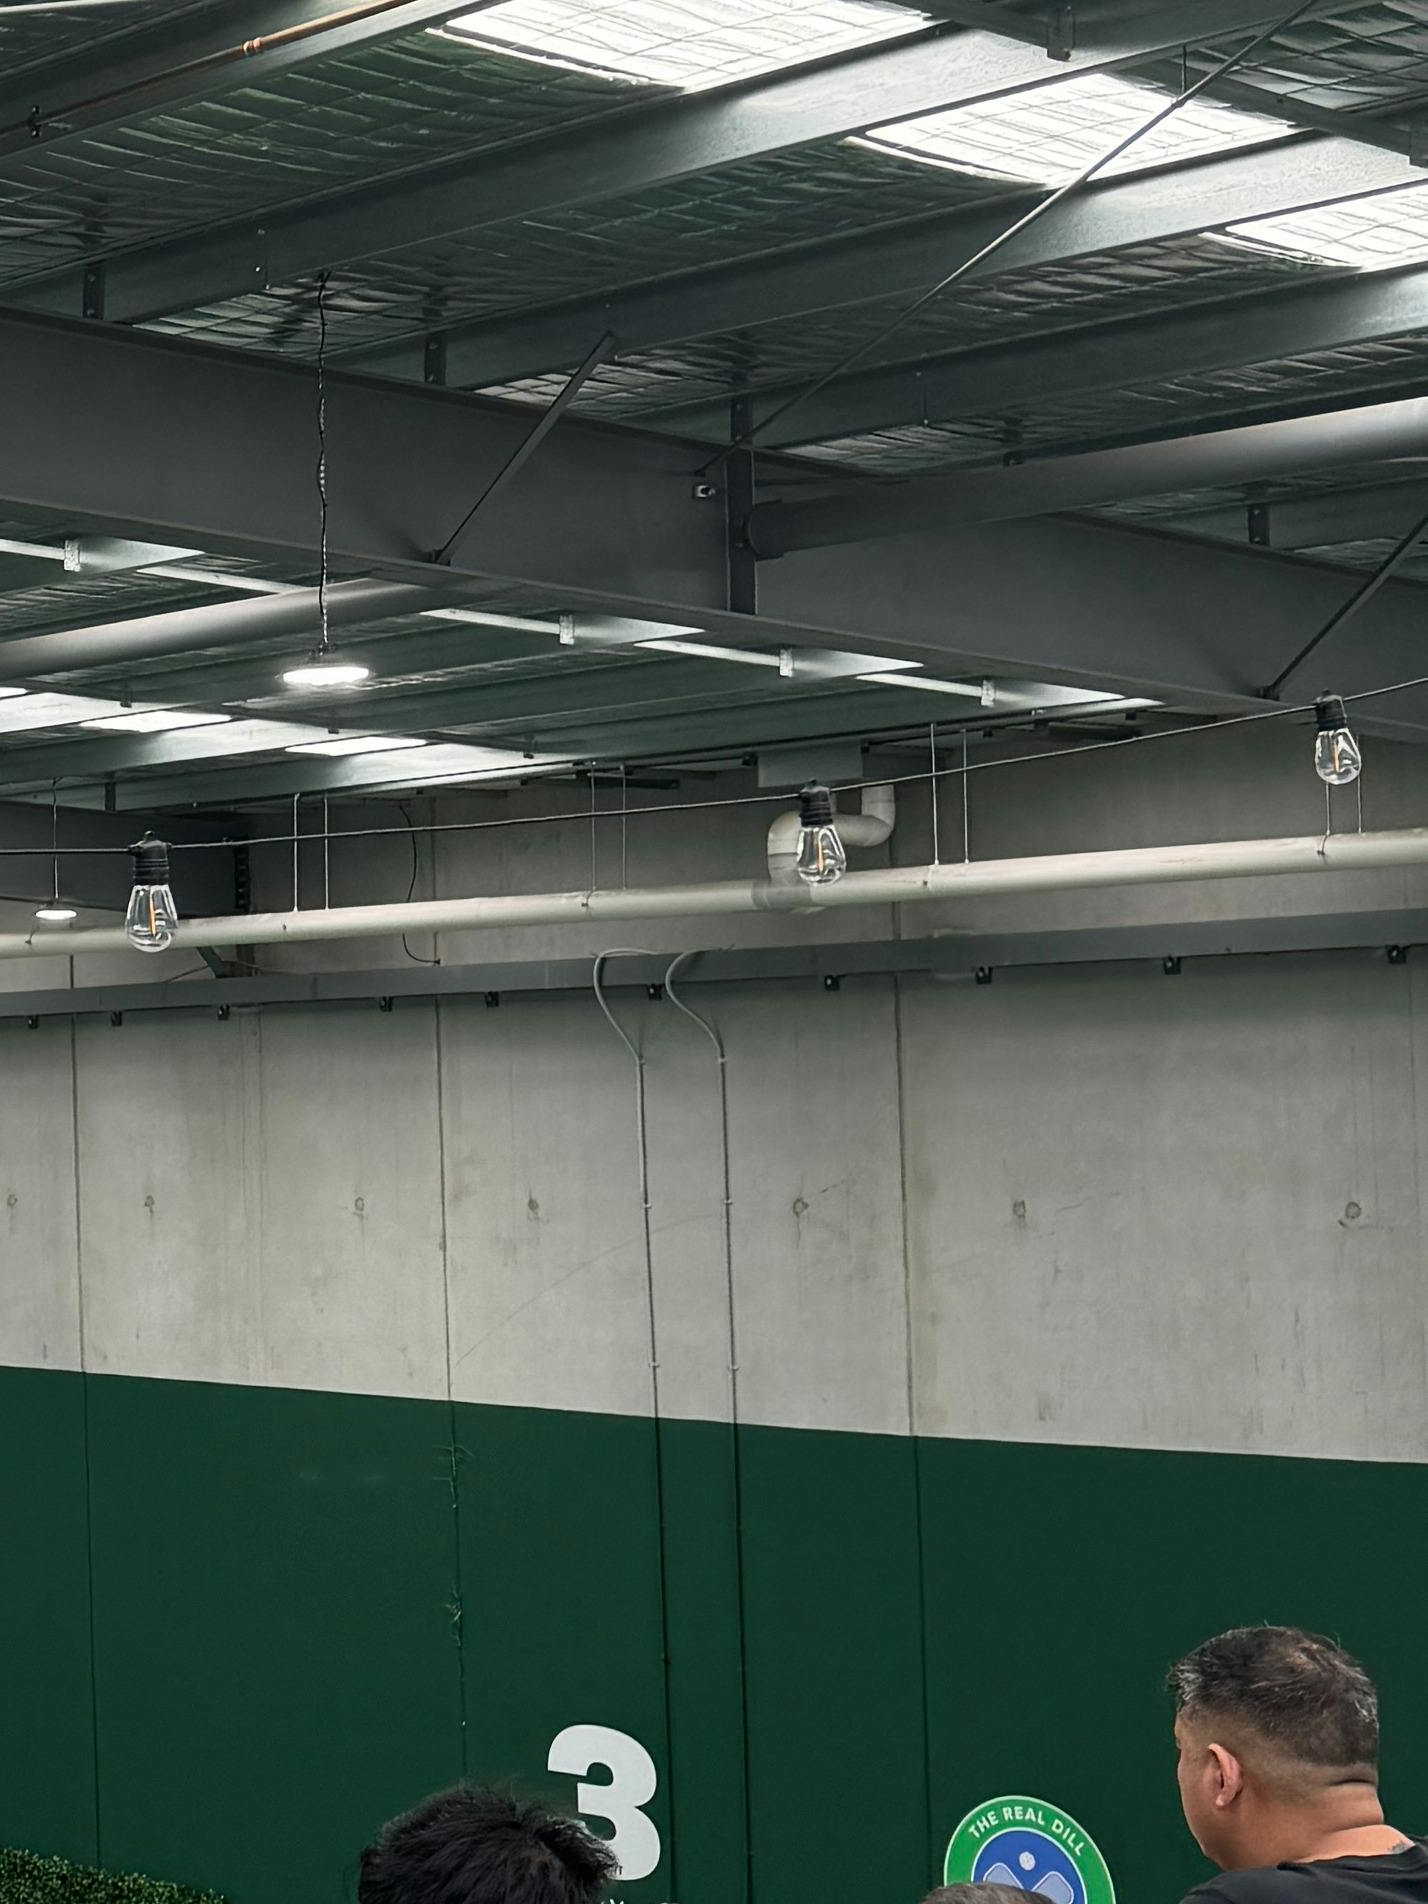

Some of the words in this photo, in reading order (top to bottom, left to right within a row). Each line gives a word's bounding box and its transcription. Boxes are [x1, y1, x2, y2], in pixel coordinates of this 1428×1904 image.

[547, 1724, 662, 1881] 3
[968, 1810, 999, 1839] THE
[1002, 1805, 1045, 1826] REAL
[1051, 1818, 1084, 1856] DILL
